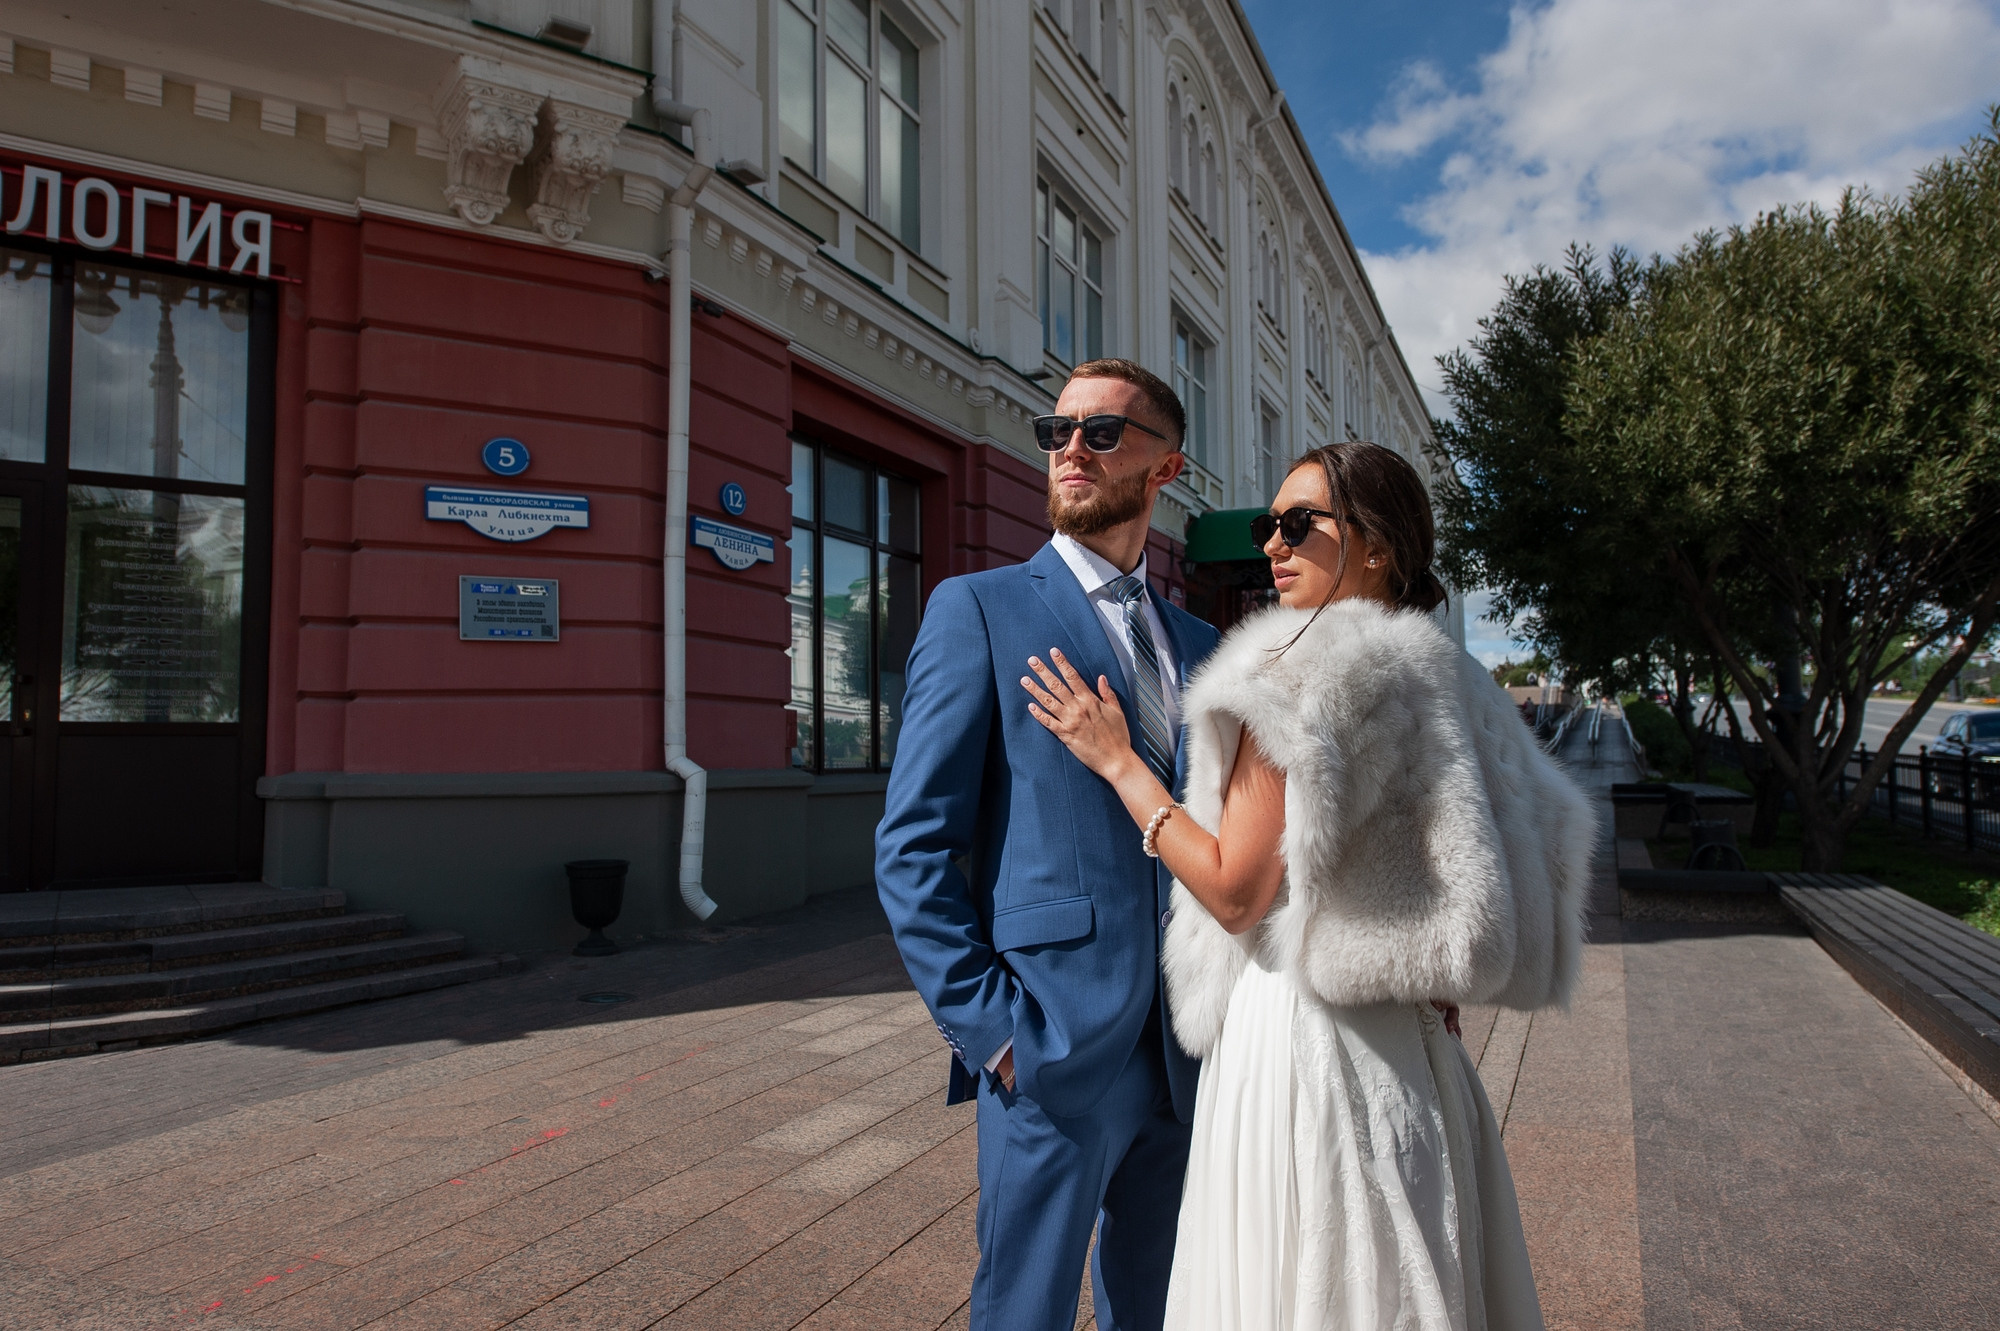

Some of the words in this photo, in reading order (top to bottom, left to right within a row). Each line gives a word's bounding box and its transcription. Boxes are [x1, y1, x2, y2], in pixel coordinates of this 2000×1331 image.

[0, 164, 272, 281] ЛОГИЯ
[498, 447, 516, 468] 5
[442, 494, 474, 503] бывшая
[478, 496, 550, 508] ГАСФОРДОВСКАЯ
[553, 502, 575, 511] улица
[728, 489, 743, 508] 12
[448, 505, 488, 519] Карла
[498, 509, 570, 523] Либкнехта
[488, 524, 535, 537] улица
[714, 536, 759, 556] ЛЕНИНА
[725, 553, 749, 566] УЛИЦА
